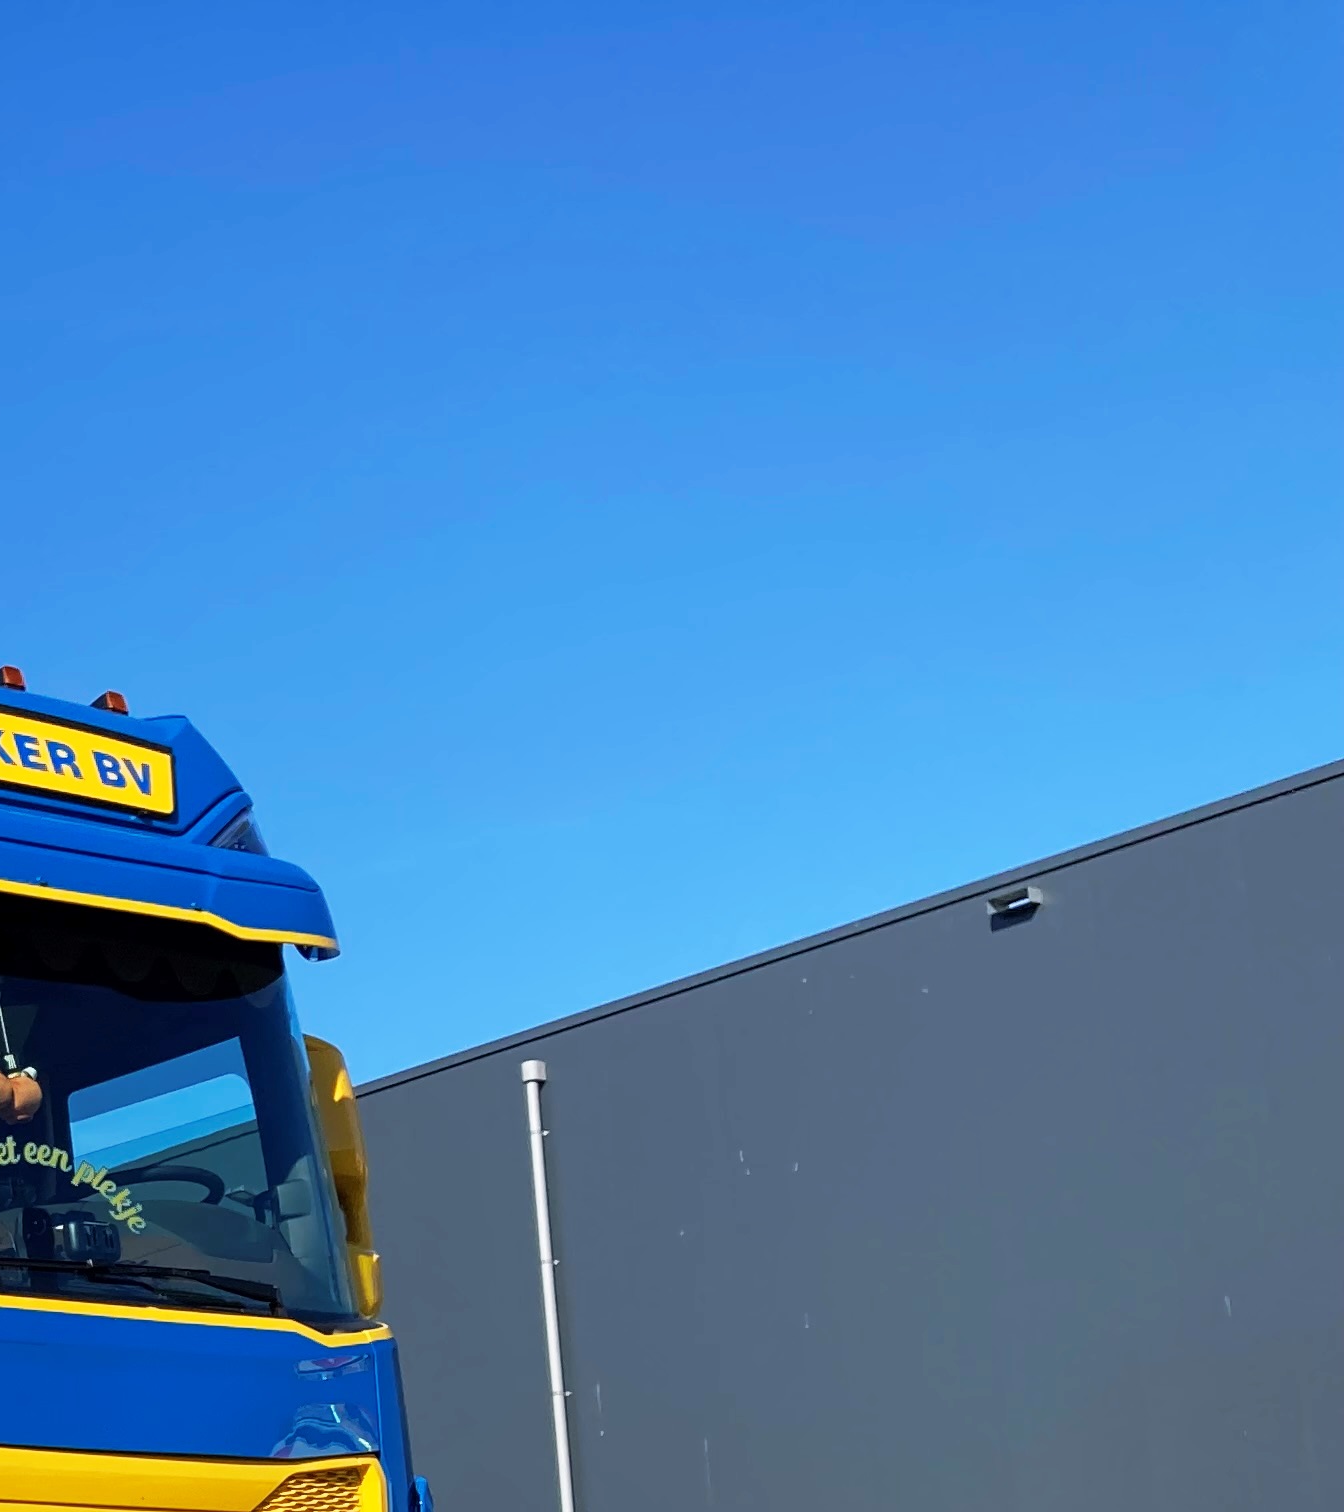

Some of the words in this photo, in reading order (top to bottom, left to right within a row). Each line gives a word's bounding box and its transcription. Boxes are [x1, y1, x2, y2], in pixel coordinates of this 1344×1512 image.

[91, 750, 153, 797] BV
[23, 1141, 73, 1172] een
[70, 1159, 147, 1235] plekje
